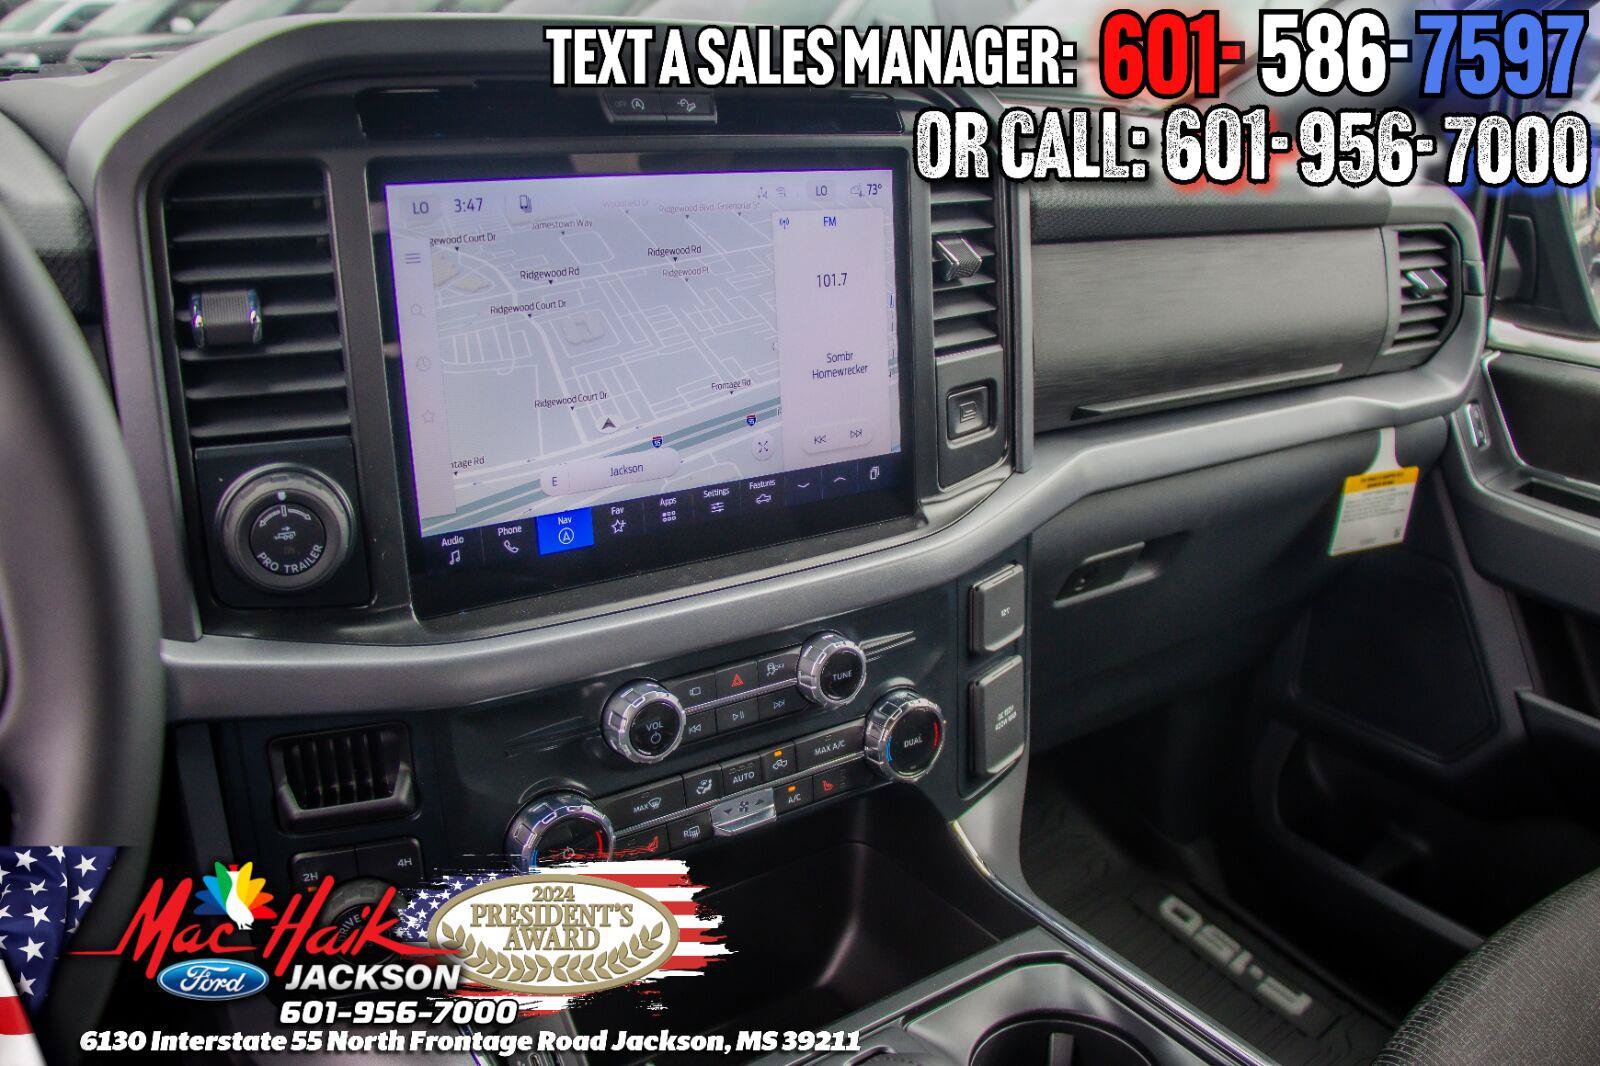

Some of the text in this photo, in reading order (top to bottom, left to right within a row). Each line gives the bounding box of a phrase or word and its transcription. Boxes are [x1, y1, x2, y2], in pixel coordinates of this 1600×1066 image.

[815, 185, 828, 197] LO
[412, 201, 429, 215] LO
[454, 198, 483, 214] 3:47
[576, 219, 593, 229] Way
[823, 216, 837, 227] FM
[463, 233, 487, 244] Court
[488, 232, 496, 242] Dr
[648, 245, 702, 258] Ridgewood Rd
[520, 267, 580, 281] Ridgewood Rd
[662, 268, 701, 279] Ridgewood
[816, 273, 848, 289] 101.7
[490, 300, 567, 315] Ridgewood Court Dr
[826, 352, 854, 364] Sombr
[812, 364, 869, 380] Homewrecker
[711, 380, 741, 391] Frontage
[534, 391, 608, 408] Ridgewood Court Dr
[473, 456, 485, 466] Rd
[610, 463, 644, 477] Jackson
[552, 476, 558, 487] E
[749, 479, 776, 490] Features
[703, 486, 730, 498] Settings
[659, 497, 677, 507] Apps
[611, 506, 624, 515] Fav
[558, 515, 572, 525] Nav
[497, 525, 522, 537] Phone
[441, 535, 464, 547] Audio
[257, 544, 324, 574] PRO TRAILER
[832, 670, 853, 681] TUNE
[646, 721, 664, 732] VOL
[814, 739, 846, 755] MAX A/C
[903, 736, 924, 748] DUAL
[733, 771, 755, 784] AUTO
[788, 794, 802, 804] A/C
[633, 802, 648, 814] MAX
[397, 858, 413, 868] 4H
[302, 872, 318, 882] 2H
